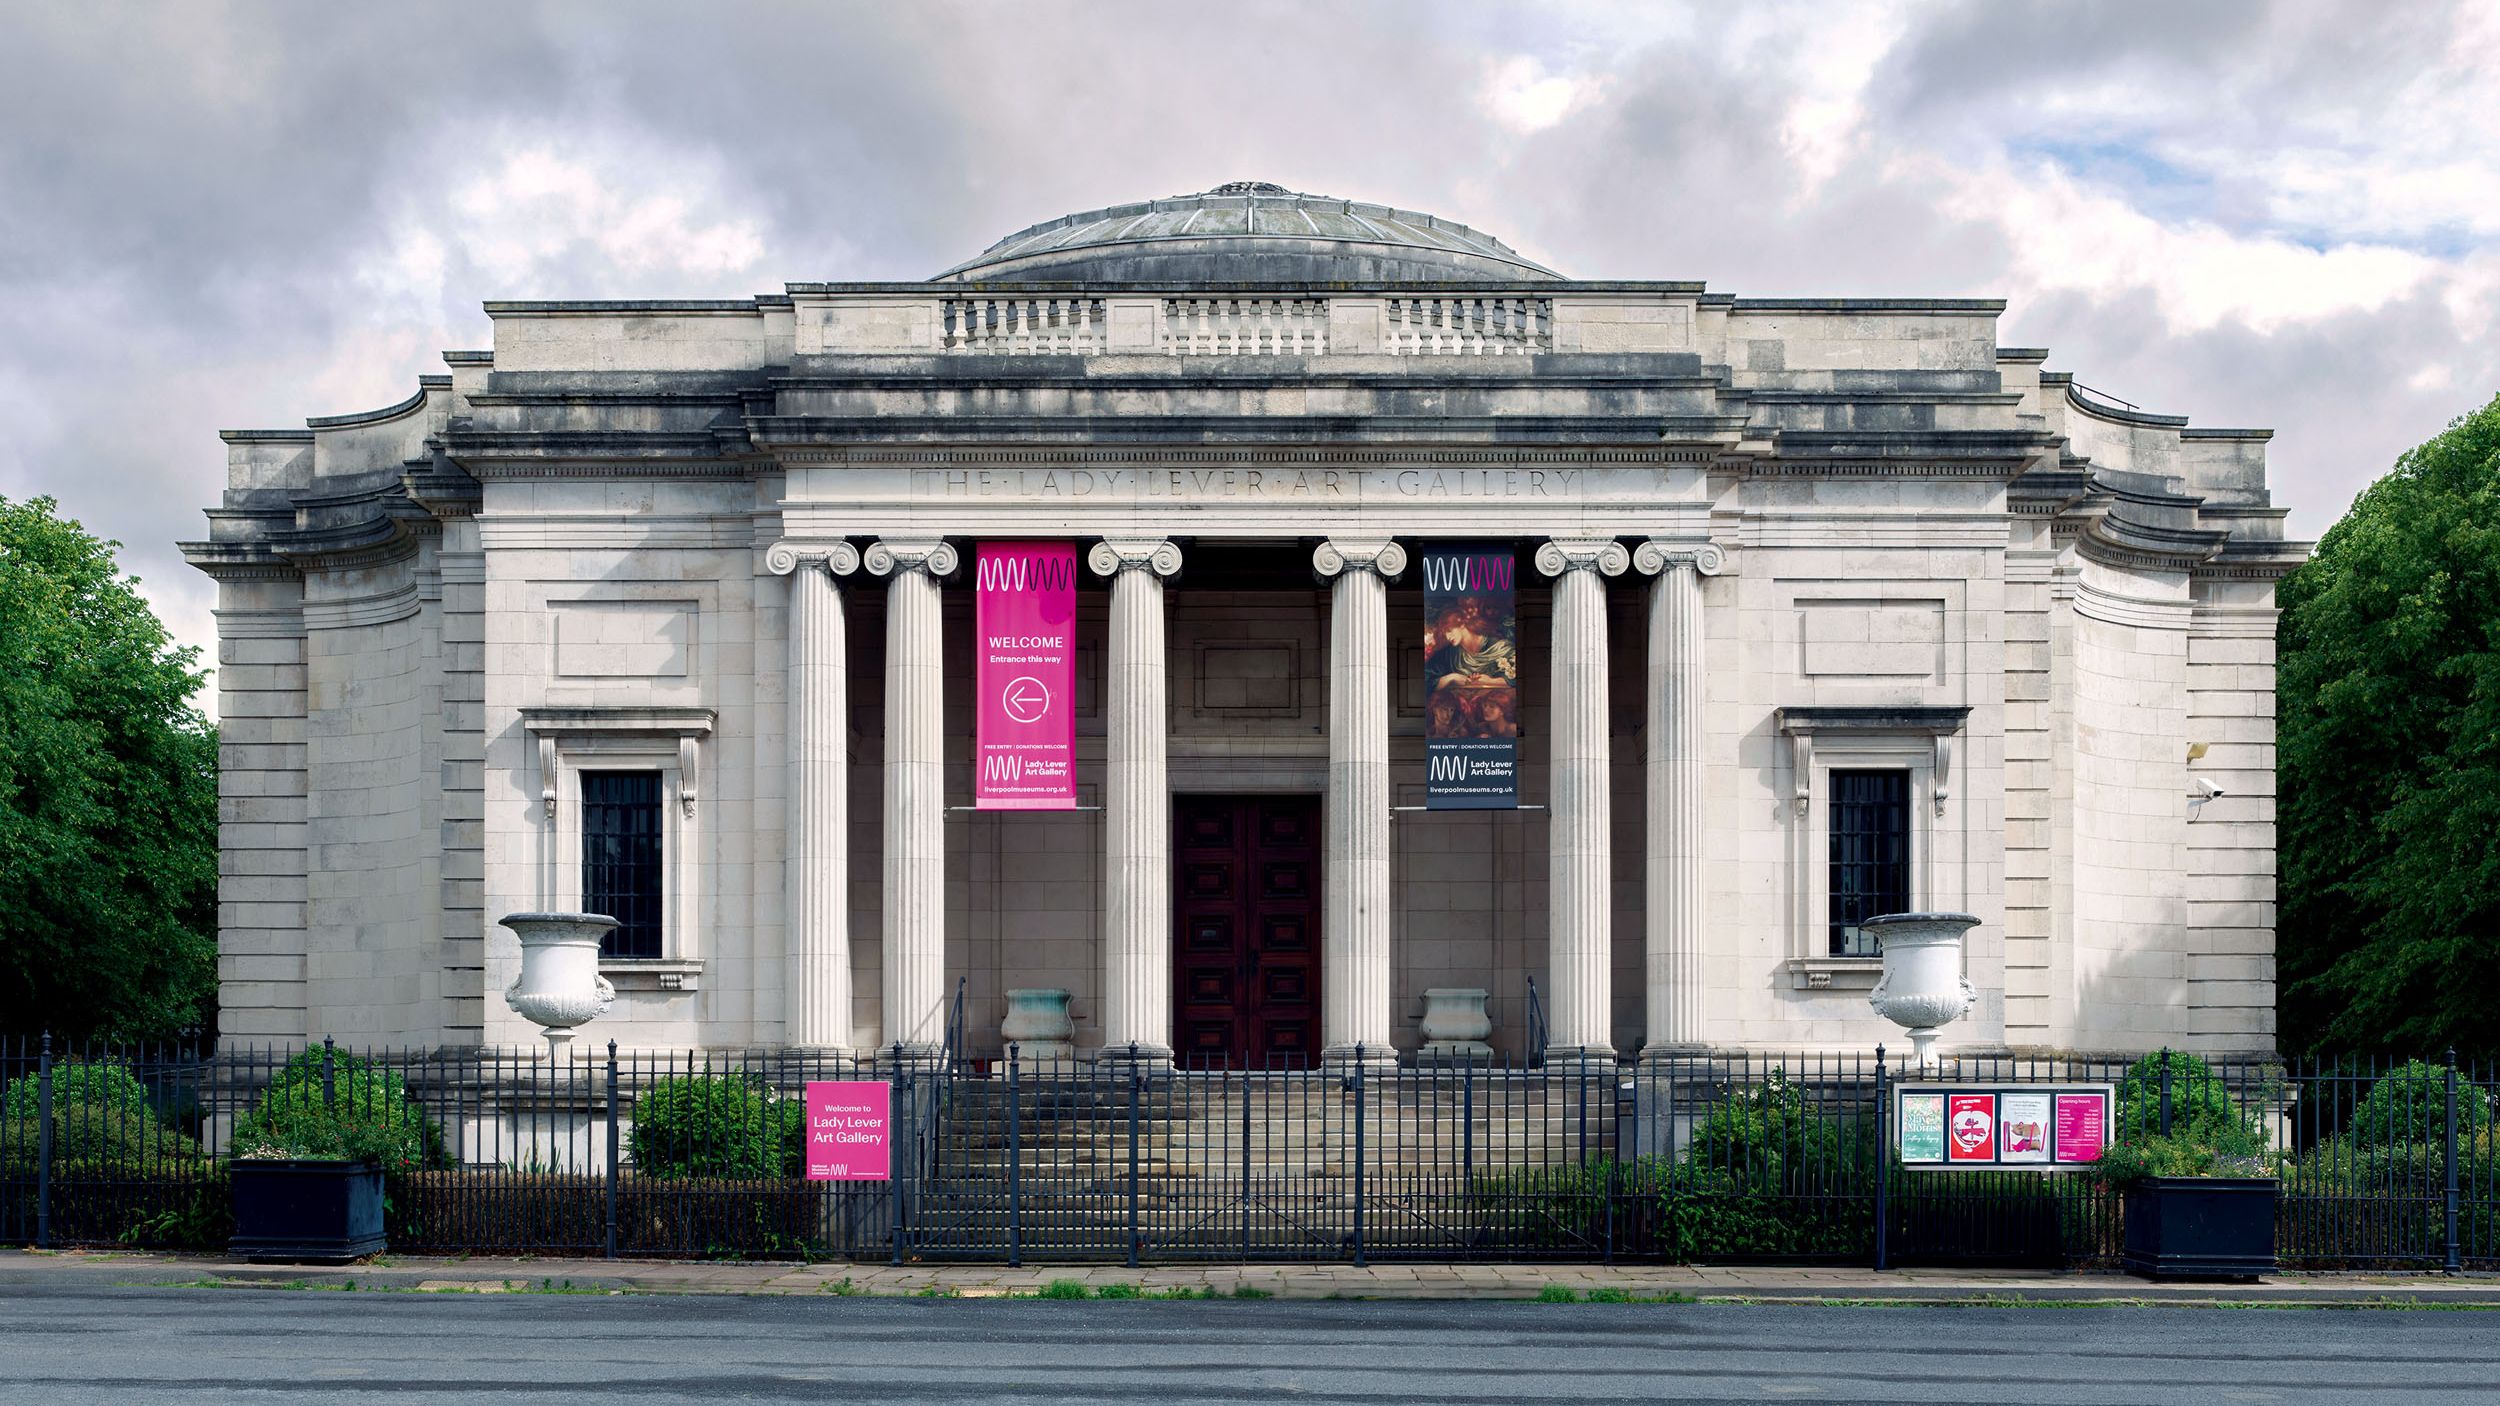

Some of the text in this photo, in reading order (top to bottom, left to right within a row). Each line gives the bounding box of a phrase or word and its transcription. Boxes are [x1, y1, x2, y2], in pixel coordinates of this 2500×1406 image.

[915, 471, 1575, 496] THE LADY LEVER ART GALLERY
[989, 636, 1063, 648] WELCOME
[990, 655, 1061, 664] Entrance this way
[1025, 760, 1067, 769] Lady Lever
[1471, 760, 1513, 769] Lady Lever
[1039, 768, 1067, 776] Gallery
[1485, 768, 1513, 776] Gallery
[825, 1104, 861, 1112] Welcome
[813, 1116, 883, 1129] Lady Lever
[1908, 1123, 1938, 1132] Morris
[813, 1131, 883, 1145] Art Gallery
